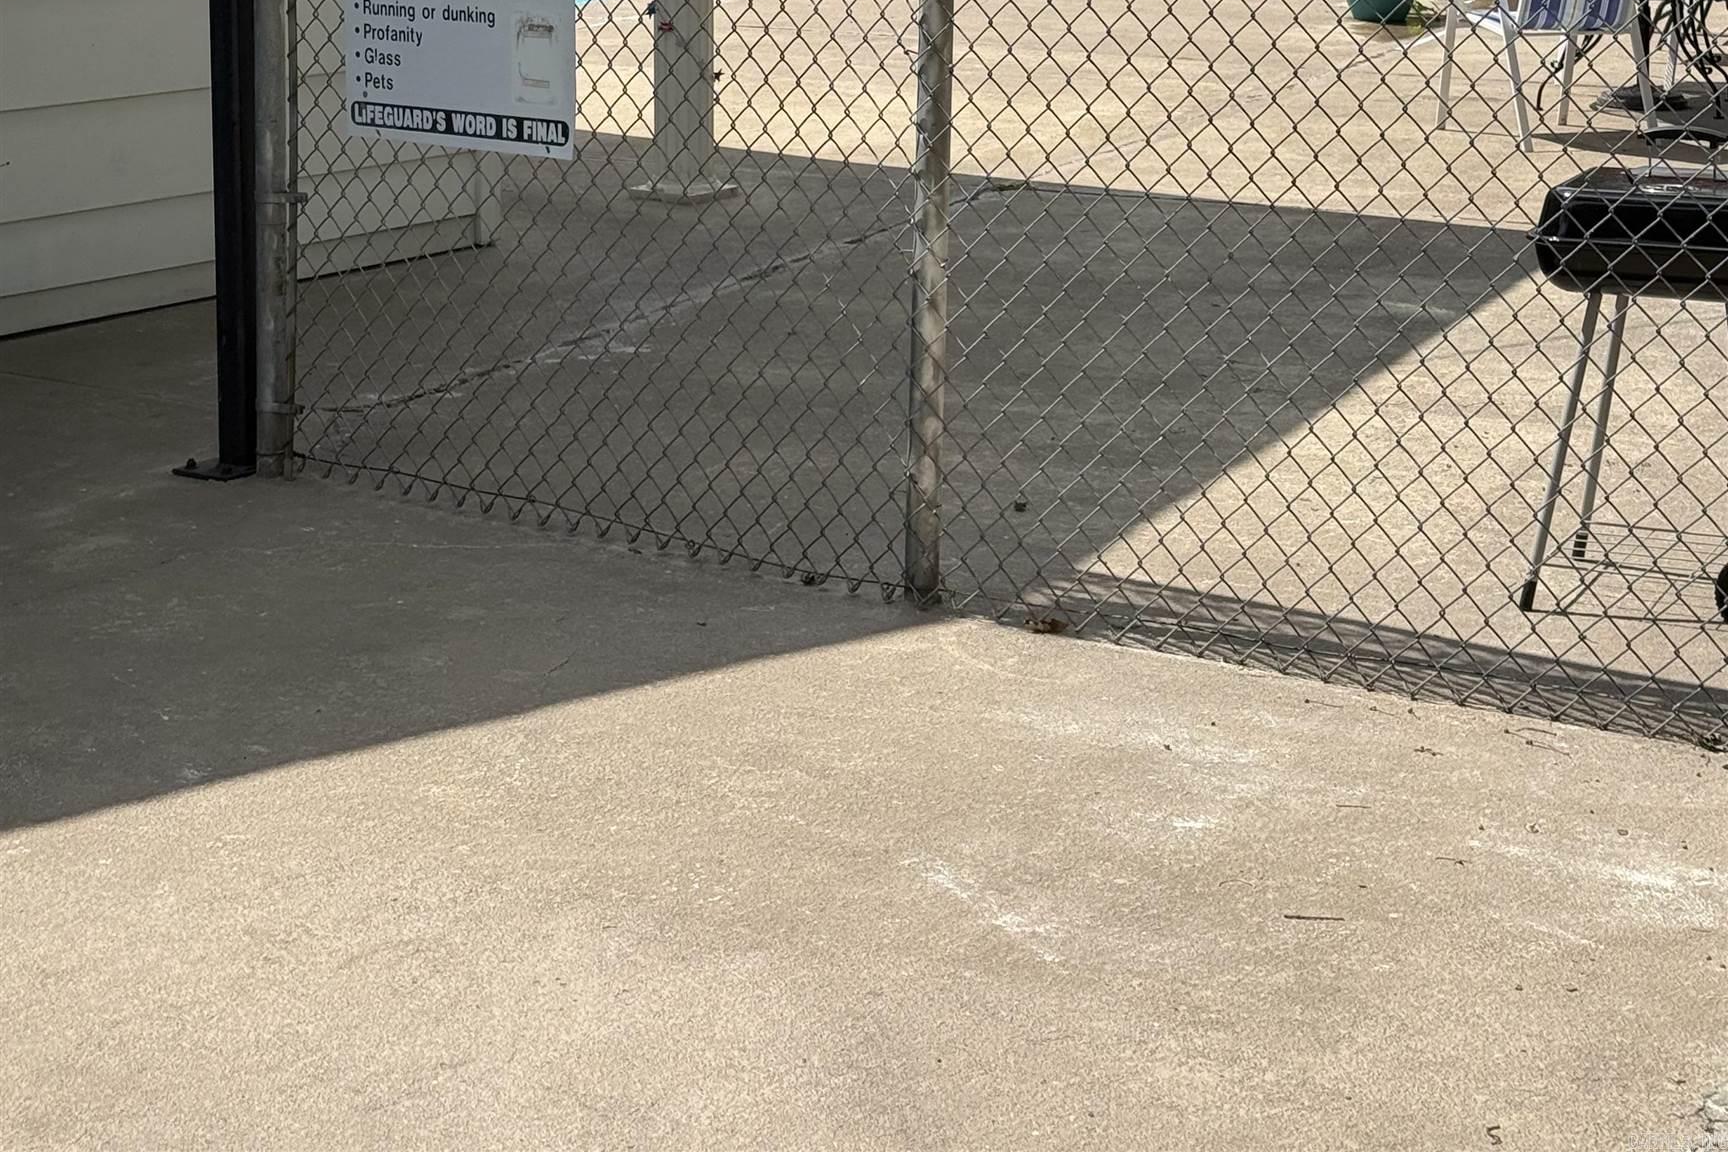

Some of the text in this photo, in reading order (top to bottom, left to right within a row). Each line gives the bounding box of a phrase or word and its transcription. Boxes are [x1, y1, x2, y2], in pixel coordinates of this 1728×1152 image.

[421, 6, 436, 20] or
[442, 5, 496, 28] dunking
[363, 23, 423, 46] Profanity
[364, 71, 394, 90] Pets
[354, 103, 566, 143] LIFEGUARD'S WORD IS FINAL
